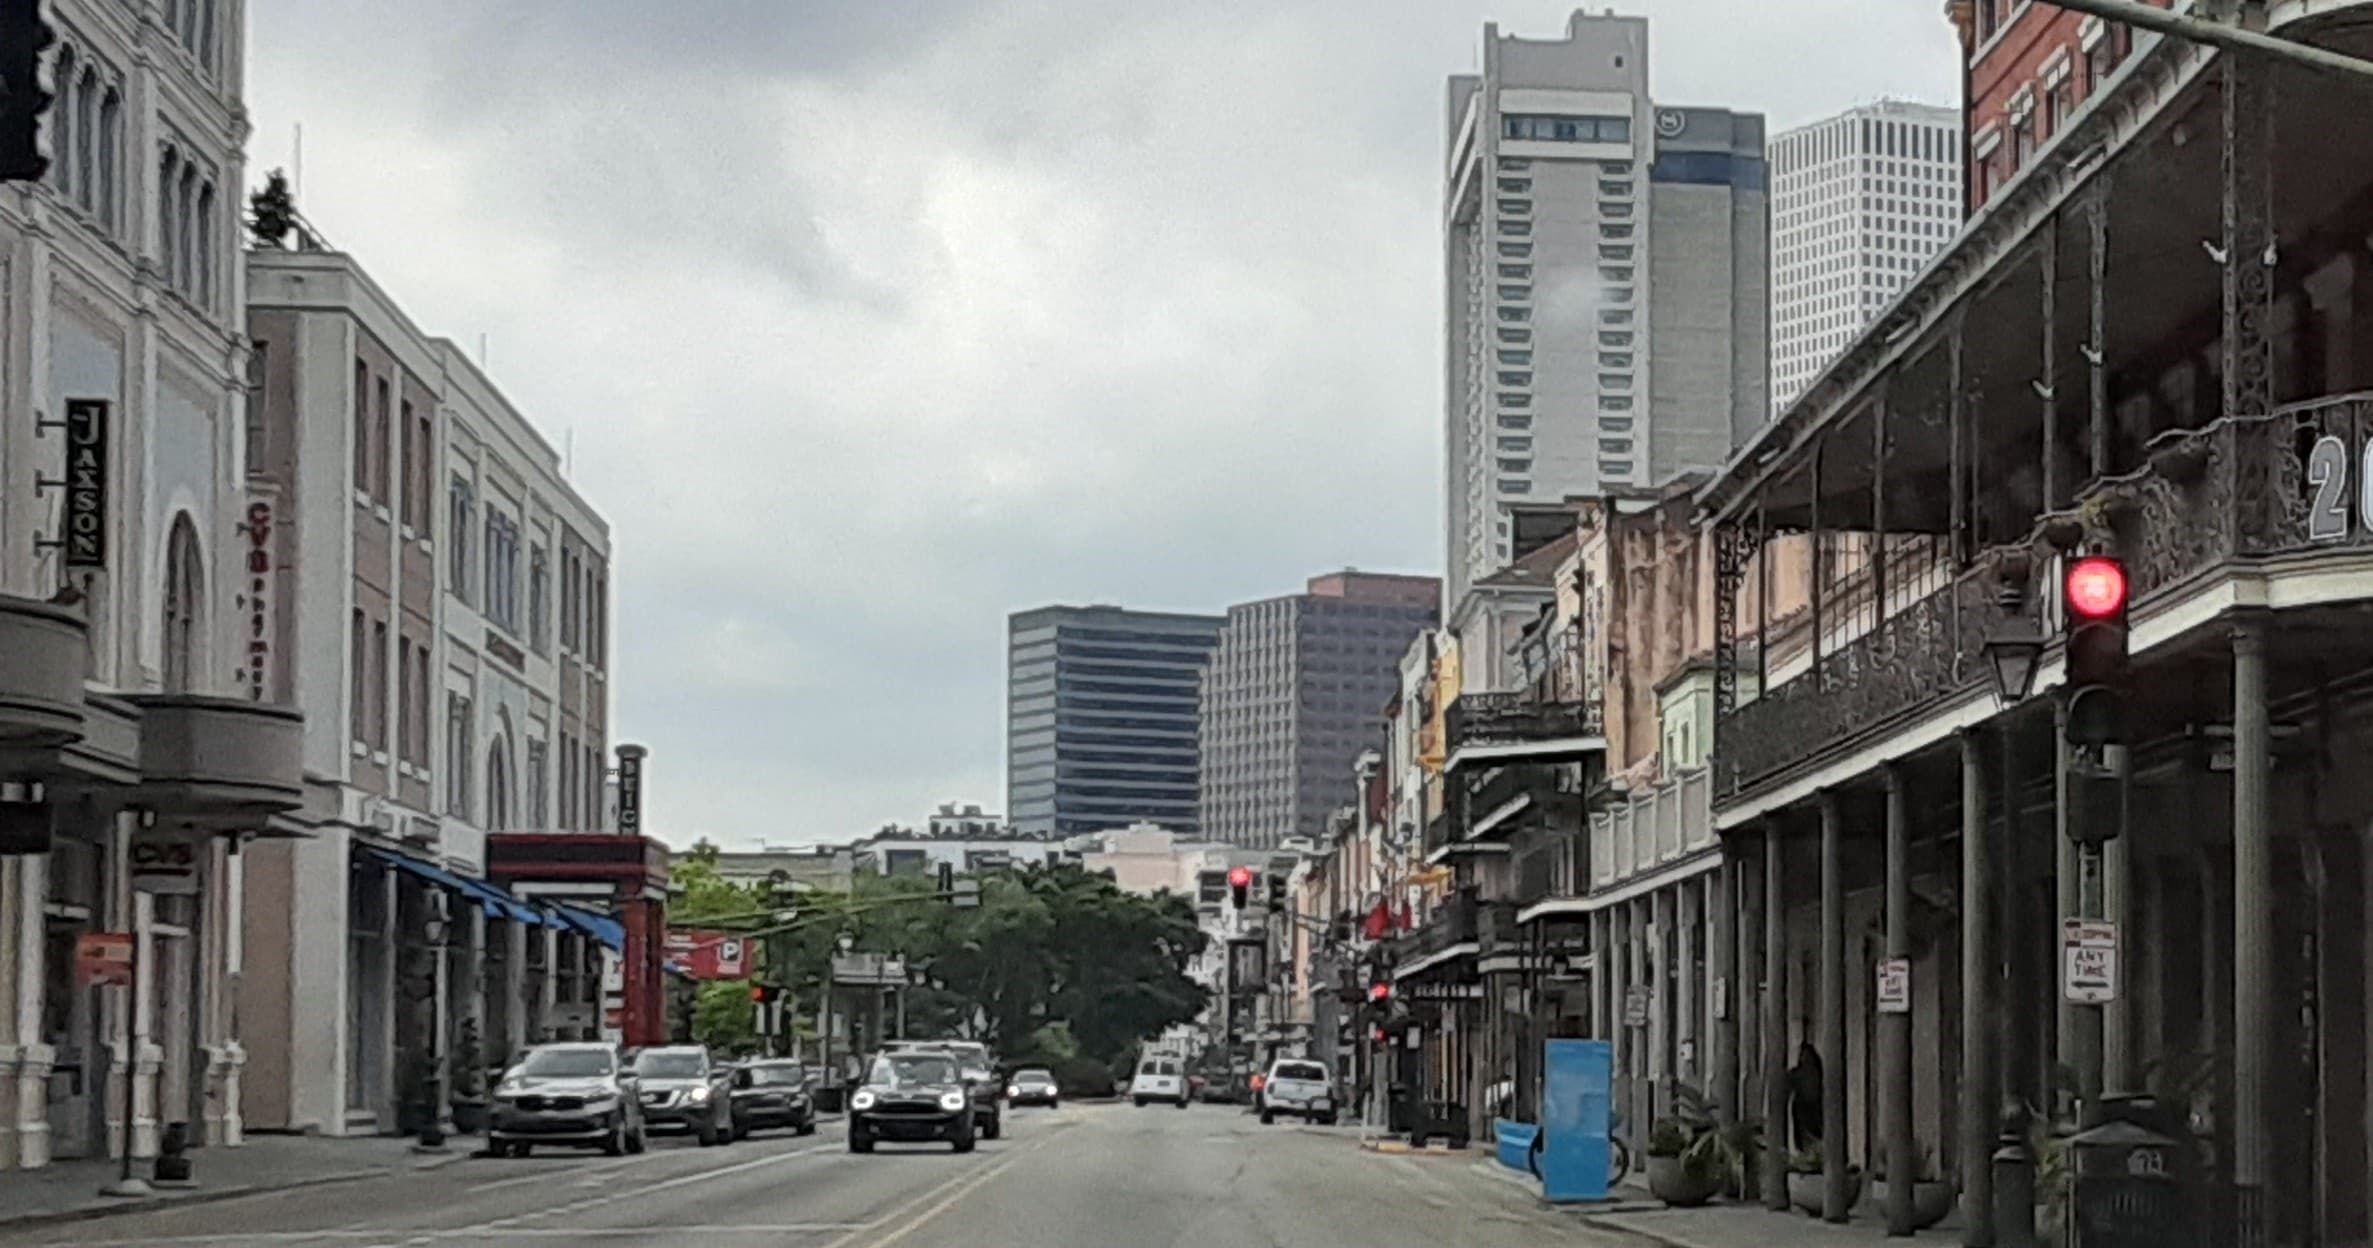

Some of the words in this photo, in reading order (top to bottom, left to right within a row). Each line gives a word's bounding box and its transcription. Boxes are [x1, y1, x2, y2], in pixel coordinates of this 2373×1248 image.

[72, 406, 99, 561] JAXSON
[248, 502, 271, 574] CVS
[133, 843, 193, 866] CVS
[723, 941, 739, 960] P
[2075, 950, 2104, 962] ANY
